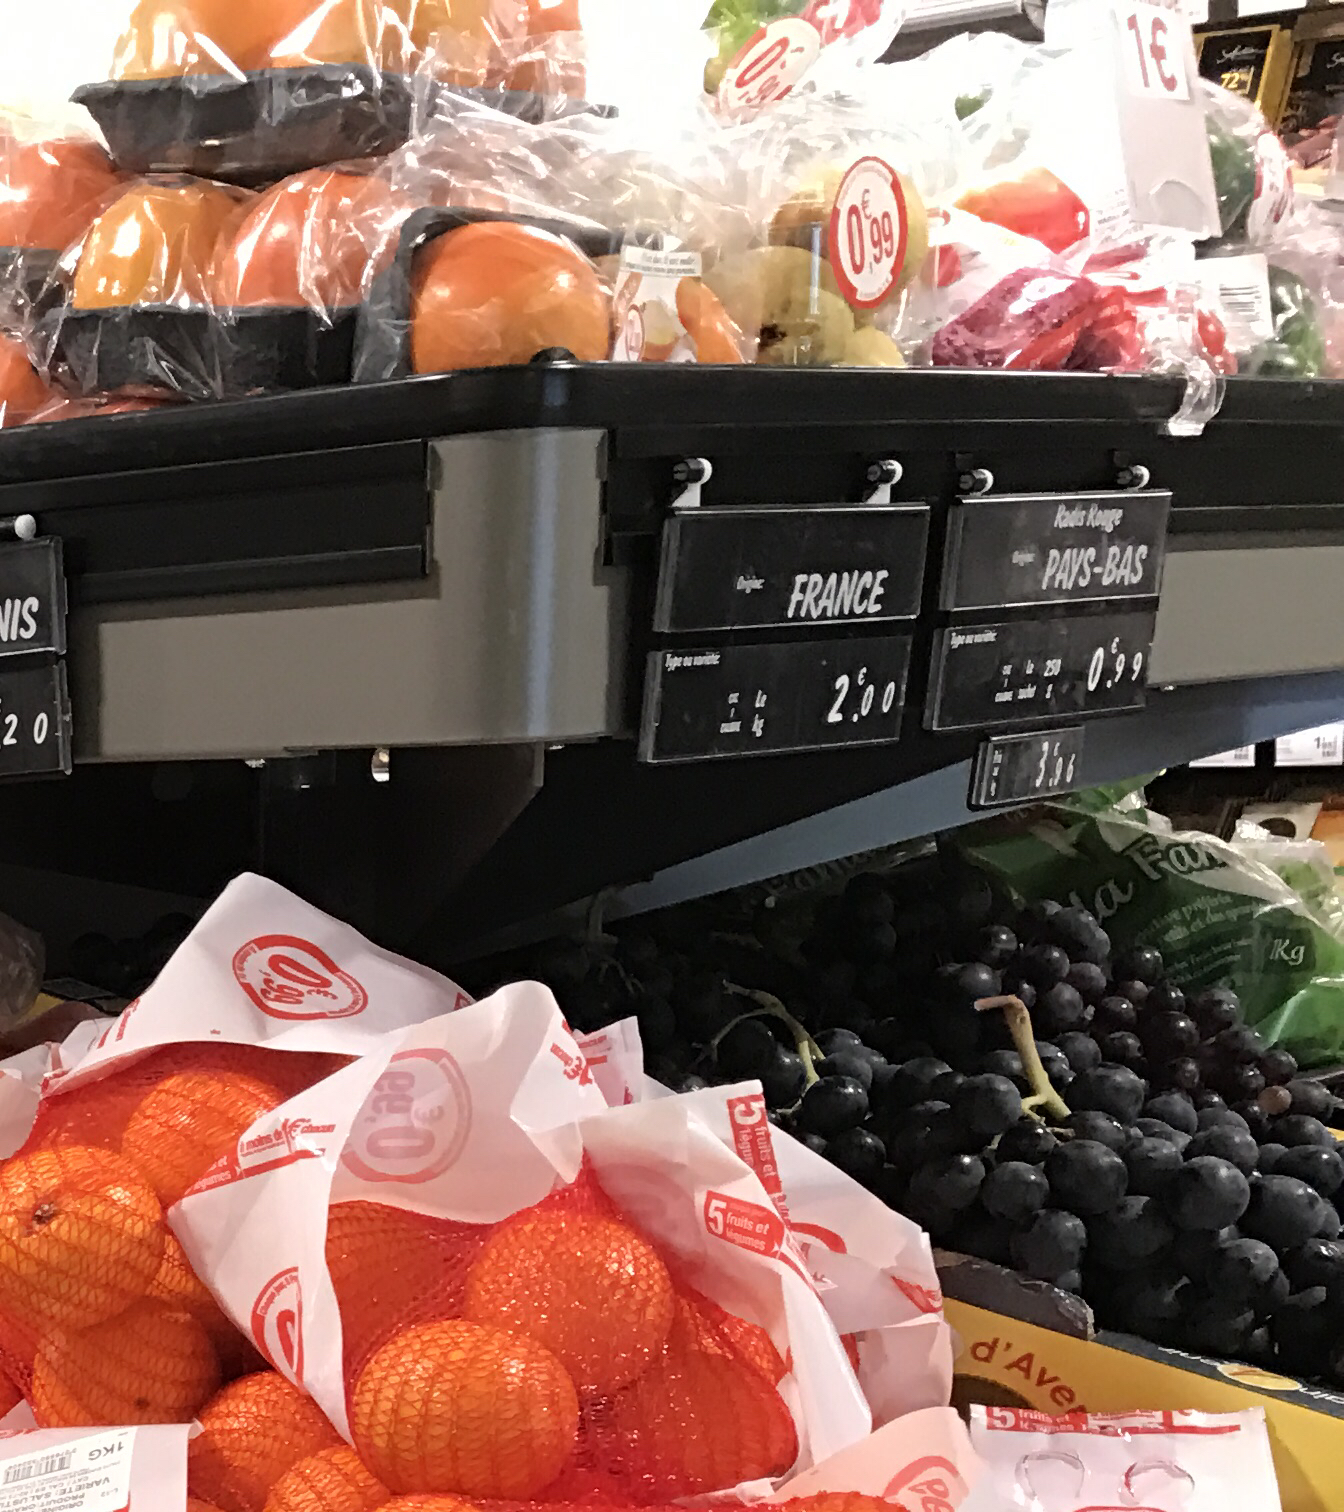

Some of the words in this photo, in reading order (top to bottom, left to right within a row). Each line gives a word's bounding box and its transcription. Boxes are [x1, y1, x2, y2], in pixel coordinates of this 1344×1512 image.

[1041, 545, 1149, 590] PAYS-BAS
[787, 569, 890, 619] FRANCE
[733, 1100, 762, 1126] 5
[754, 1125, 772, 1162] fruits
[762, 1162, 777, 1178] et
[707, 1198, 727, 1235] 5
[726, 1211, 753, 1232] fruits
[755, 1222, 770, 1235] et
[995, 1406, 1016, 1428] 5
[87, 1440, 125, 1461] 1KG
